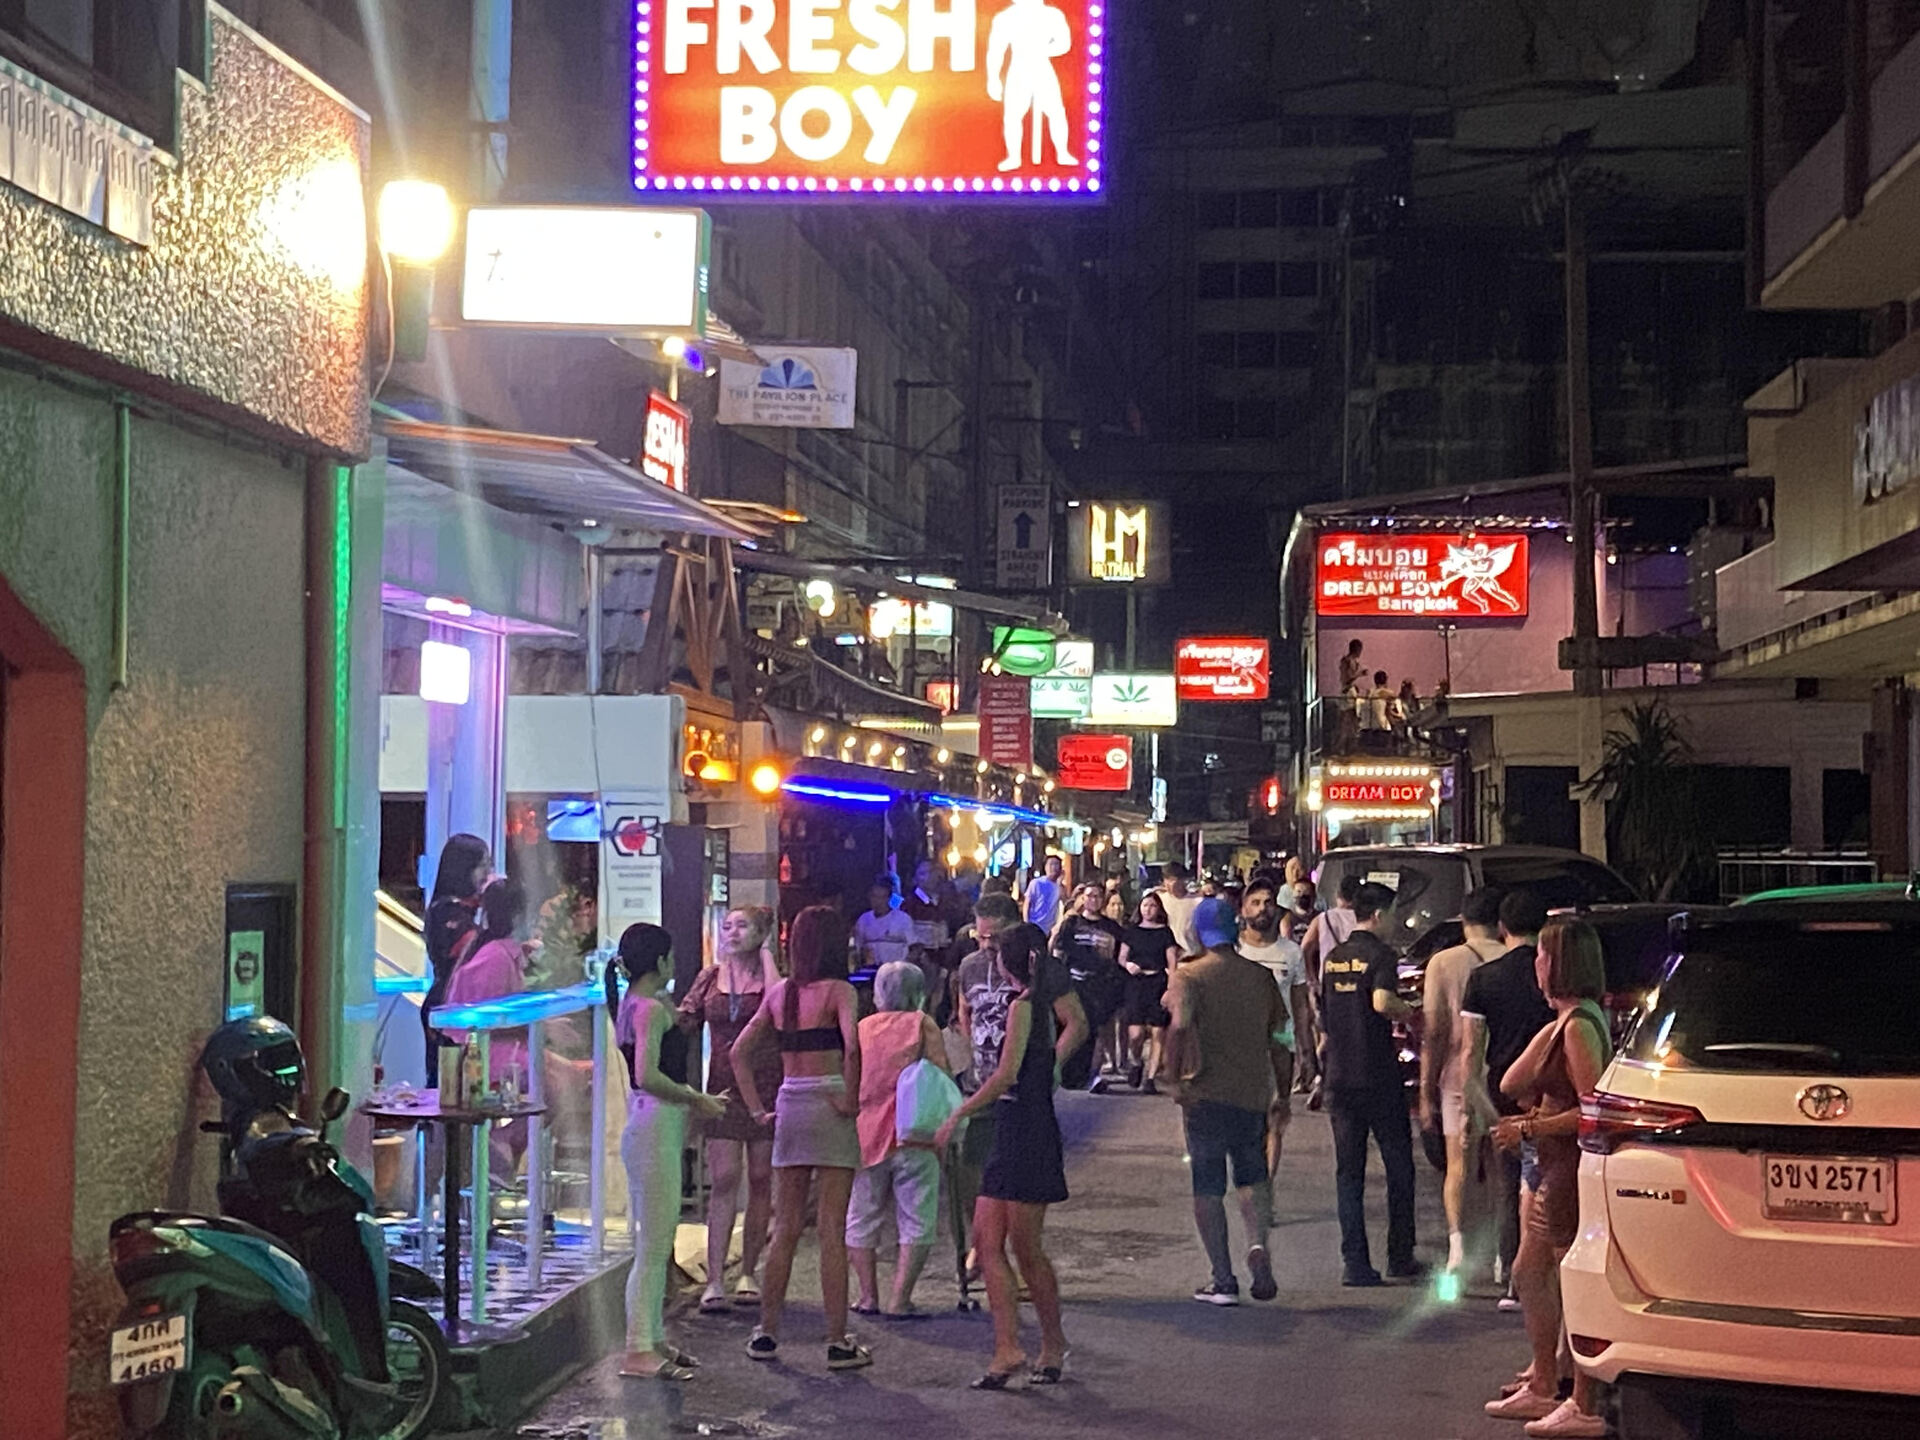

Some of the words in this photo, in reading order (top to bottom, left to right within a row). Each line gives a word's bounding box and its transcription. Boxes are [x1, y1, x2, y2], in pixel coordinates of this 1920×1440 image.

[662, 0, 977, 76] FRESH
[719, 85, 918, 165] BOY
[753, 391, 806, 402] PAVILION
[810, 392, 848, 404] PLACE
[1323, 581, 1395, 597] DREAM
[1401, 581, 1442, 597] BOY
[1377, 596, 1459, 614] Bangkok
[1329, 786, 1385, 800] DREAM
[1390, 786, 1425, 801] BOY
[1770, 1164, 1818, 1190] 3ขง
[1825, 1165, 1882, 1193] 2571
[120, 1356, 176, 1380] 4460
